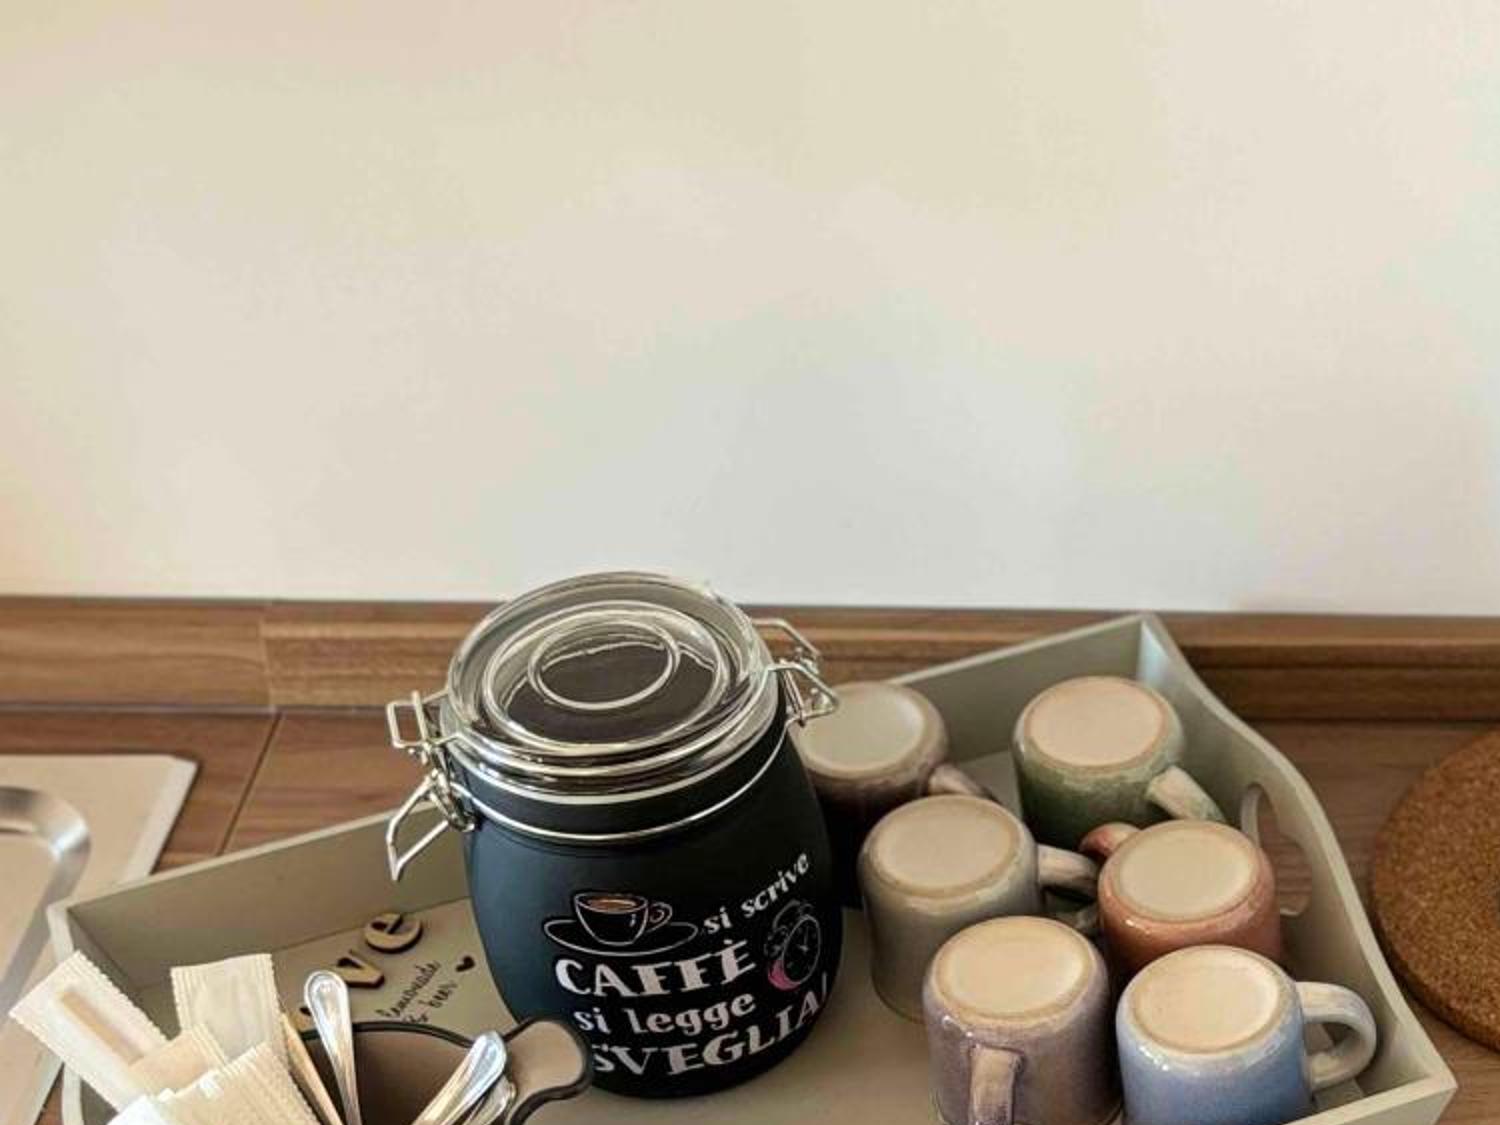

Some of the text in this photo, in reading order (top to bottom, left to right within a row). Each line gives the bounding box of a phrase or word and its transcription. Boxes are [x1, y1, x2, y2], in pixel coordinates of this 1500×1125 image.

[703, 853, 810, 935] si scrive
[555, 939, 756, 998] CAFFÈ
[574, 994, 756, 1035] si legge
